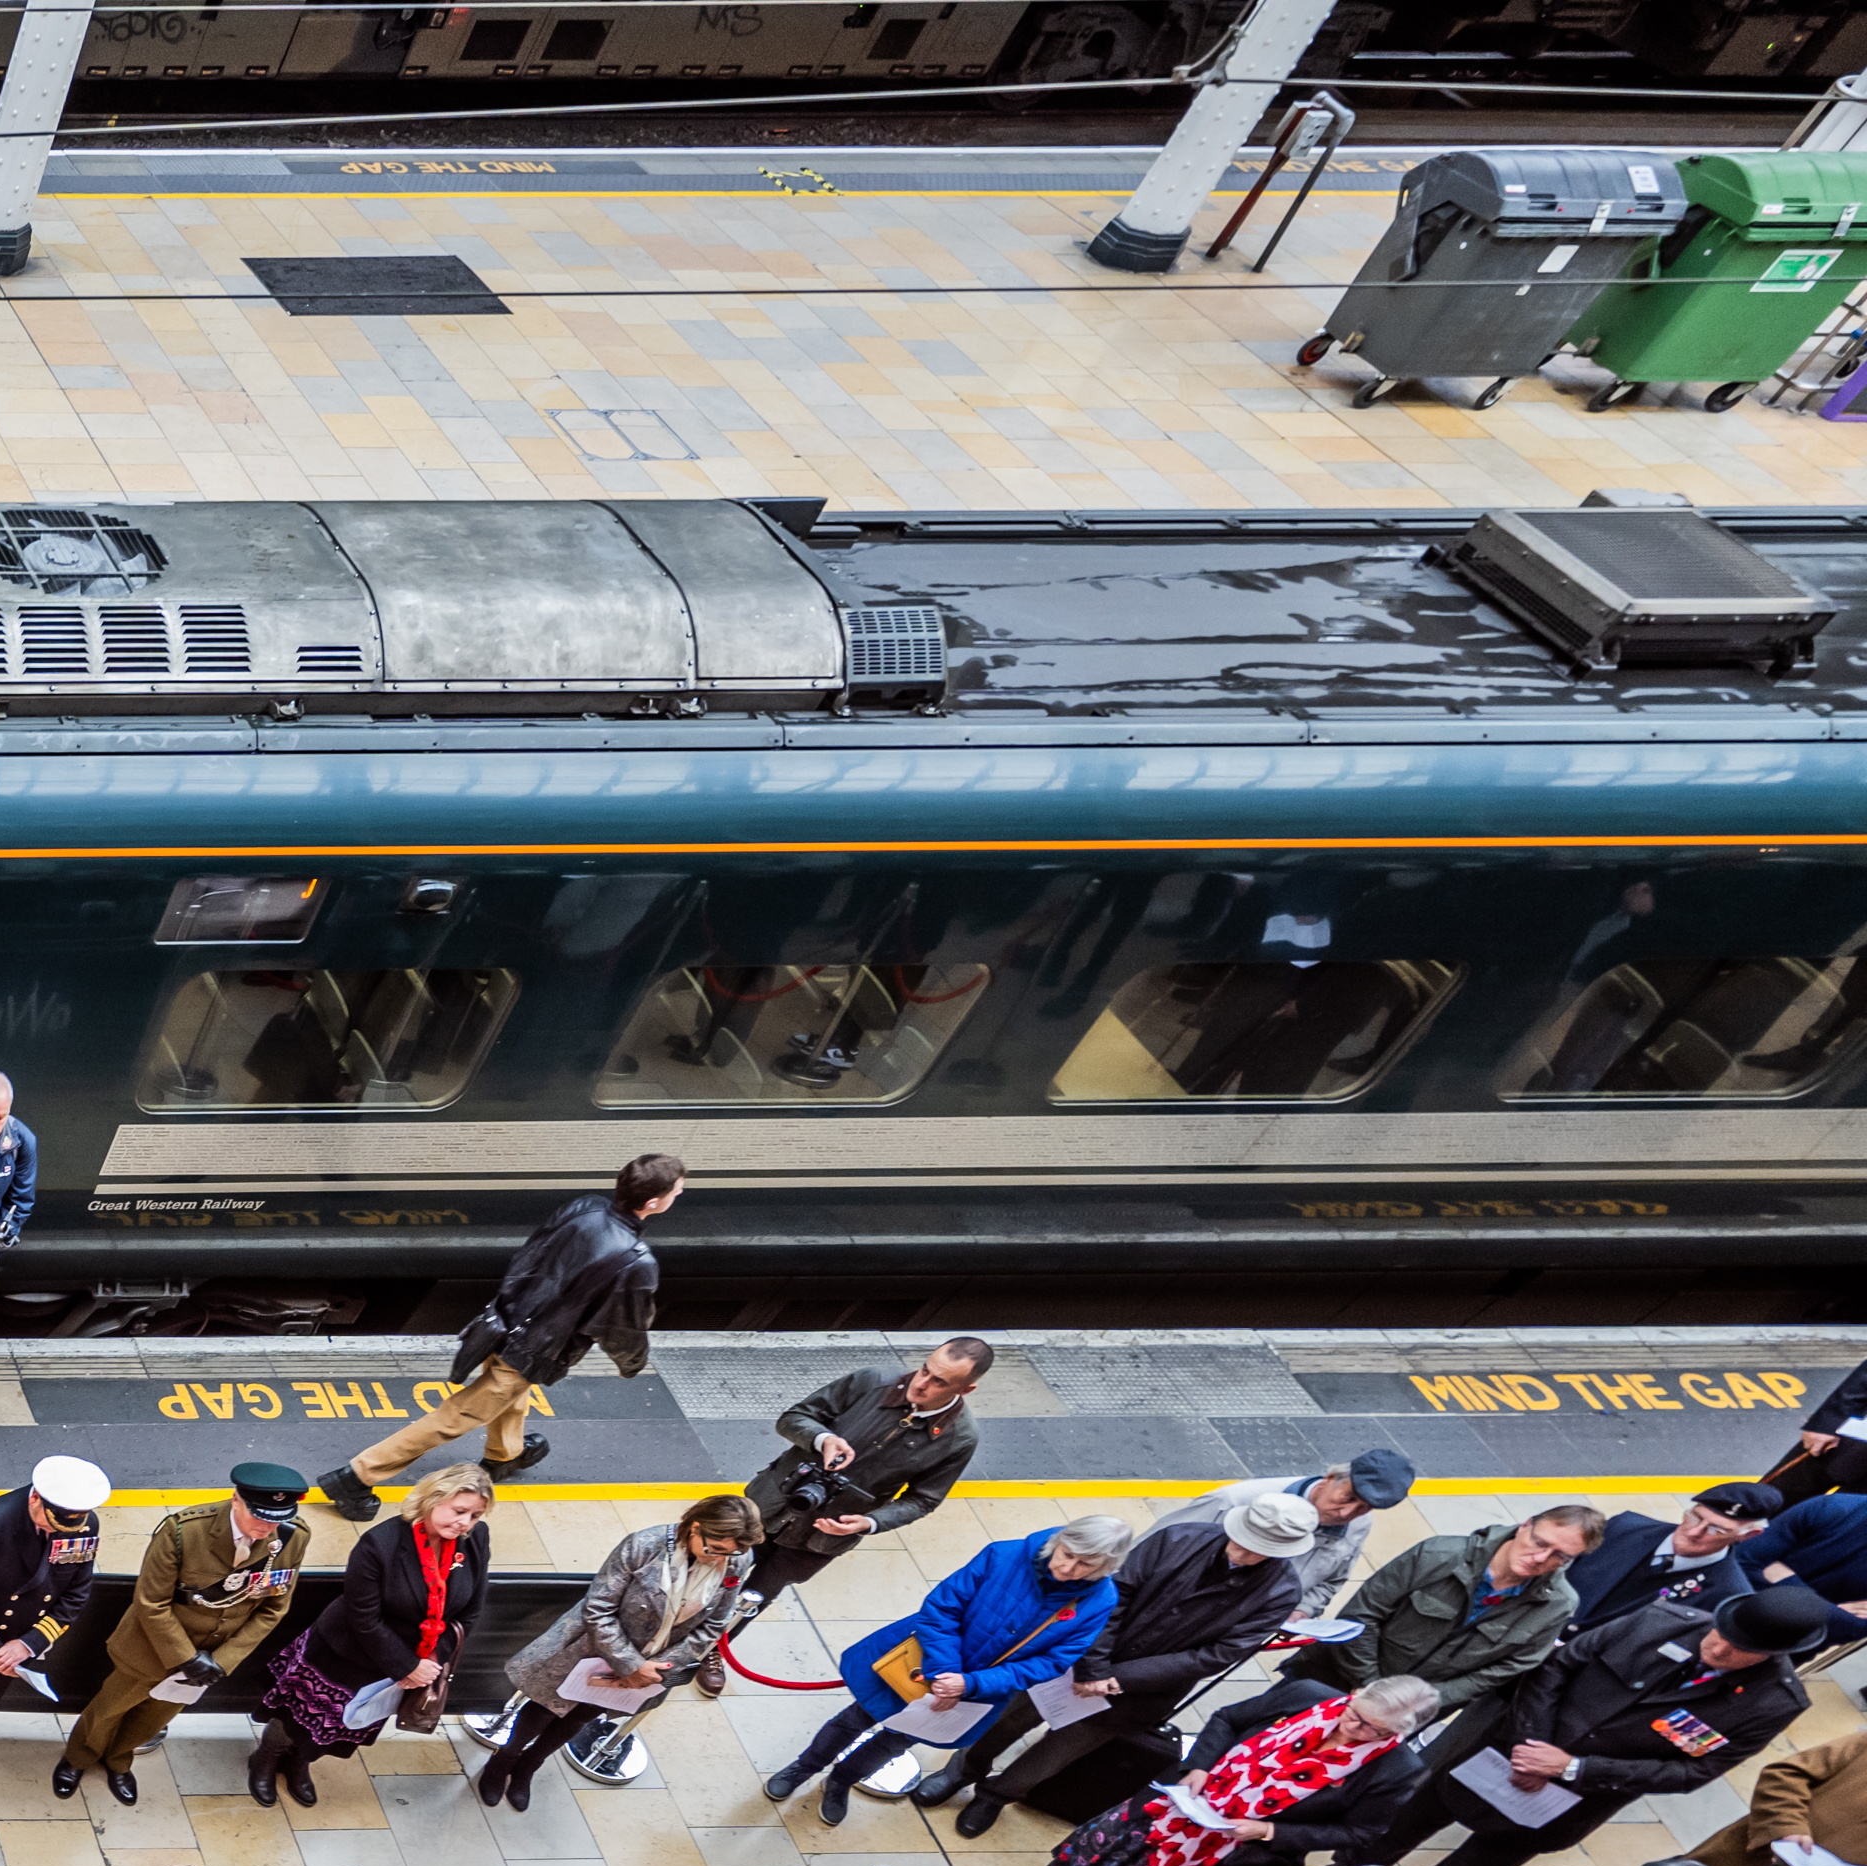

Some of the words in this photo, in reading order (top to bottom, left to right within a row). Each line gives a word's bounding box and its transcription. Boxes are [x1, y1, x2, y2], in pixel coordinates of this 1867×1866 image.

[339, 161, 408, 173] GAP
[413, 161, 477, 173] THE
[478, 161, 556, 173] MIND
[300, 878, 318, 899] J
[87, 1200, 131, 1211] Great
[135, 1199, 198, 1211] Western
[200, 1198, 266, 1212] Railway
[292, 1381, 409, 1418] THE
[1409, 1373, 1560, 1411] MIND
[1553, 1373, 1684, 1411] THE
[1678, 1371, 1808, 1410] GAP
[158, 1381, 282, 1419] GAP
